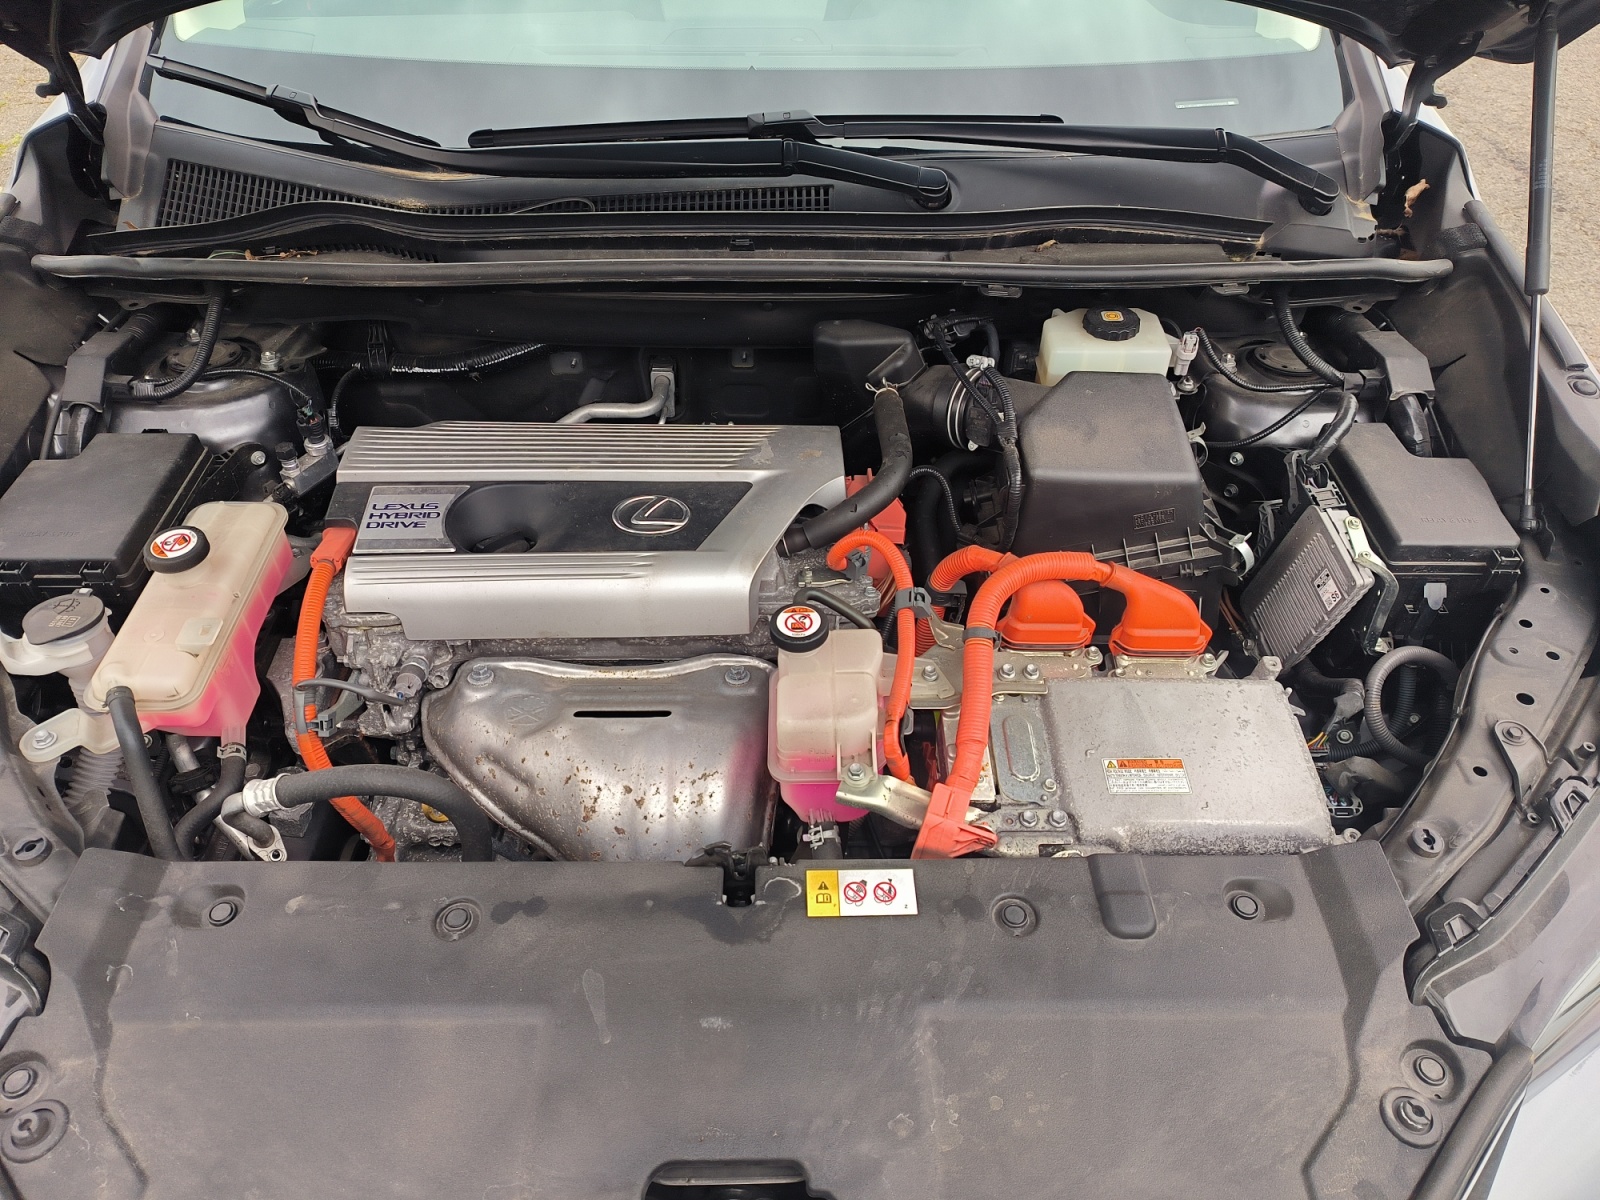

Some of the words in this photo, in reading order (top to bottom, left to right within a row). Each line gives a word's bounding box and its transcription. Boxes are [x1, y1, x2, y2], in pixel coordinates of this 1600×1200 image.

[372, 502, 440, 511] LEXUS
[368, 511, 441, 520] HYBRID
[365, 520, 428, 529] DRIVE
